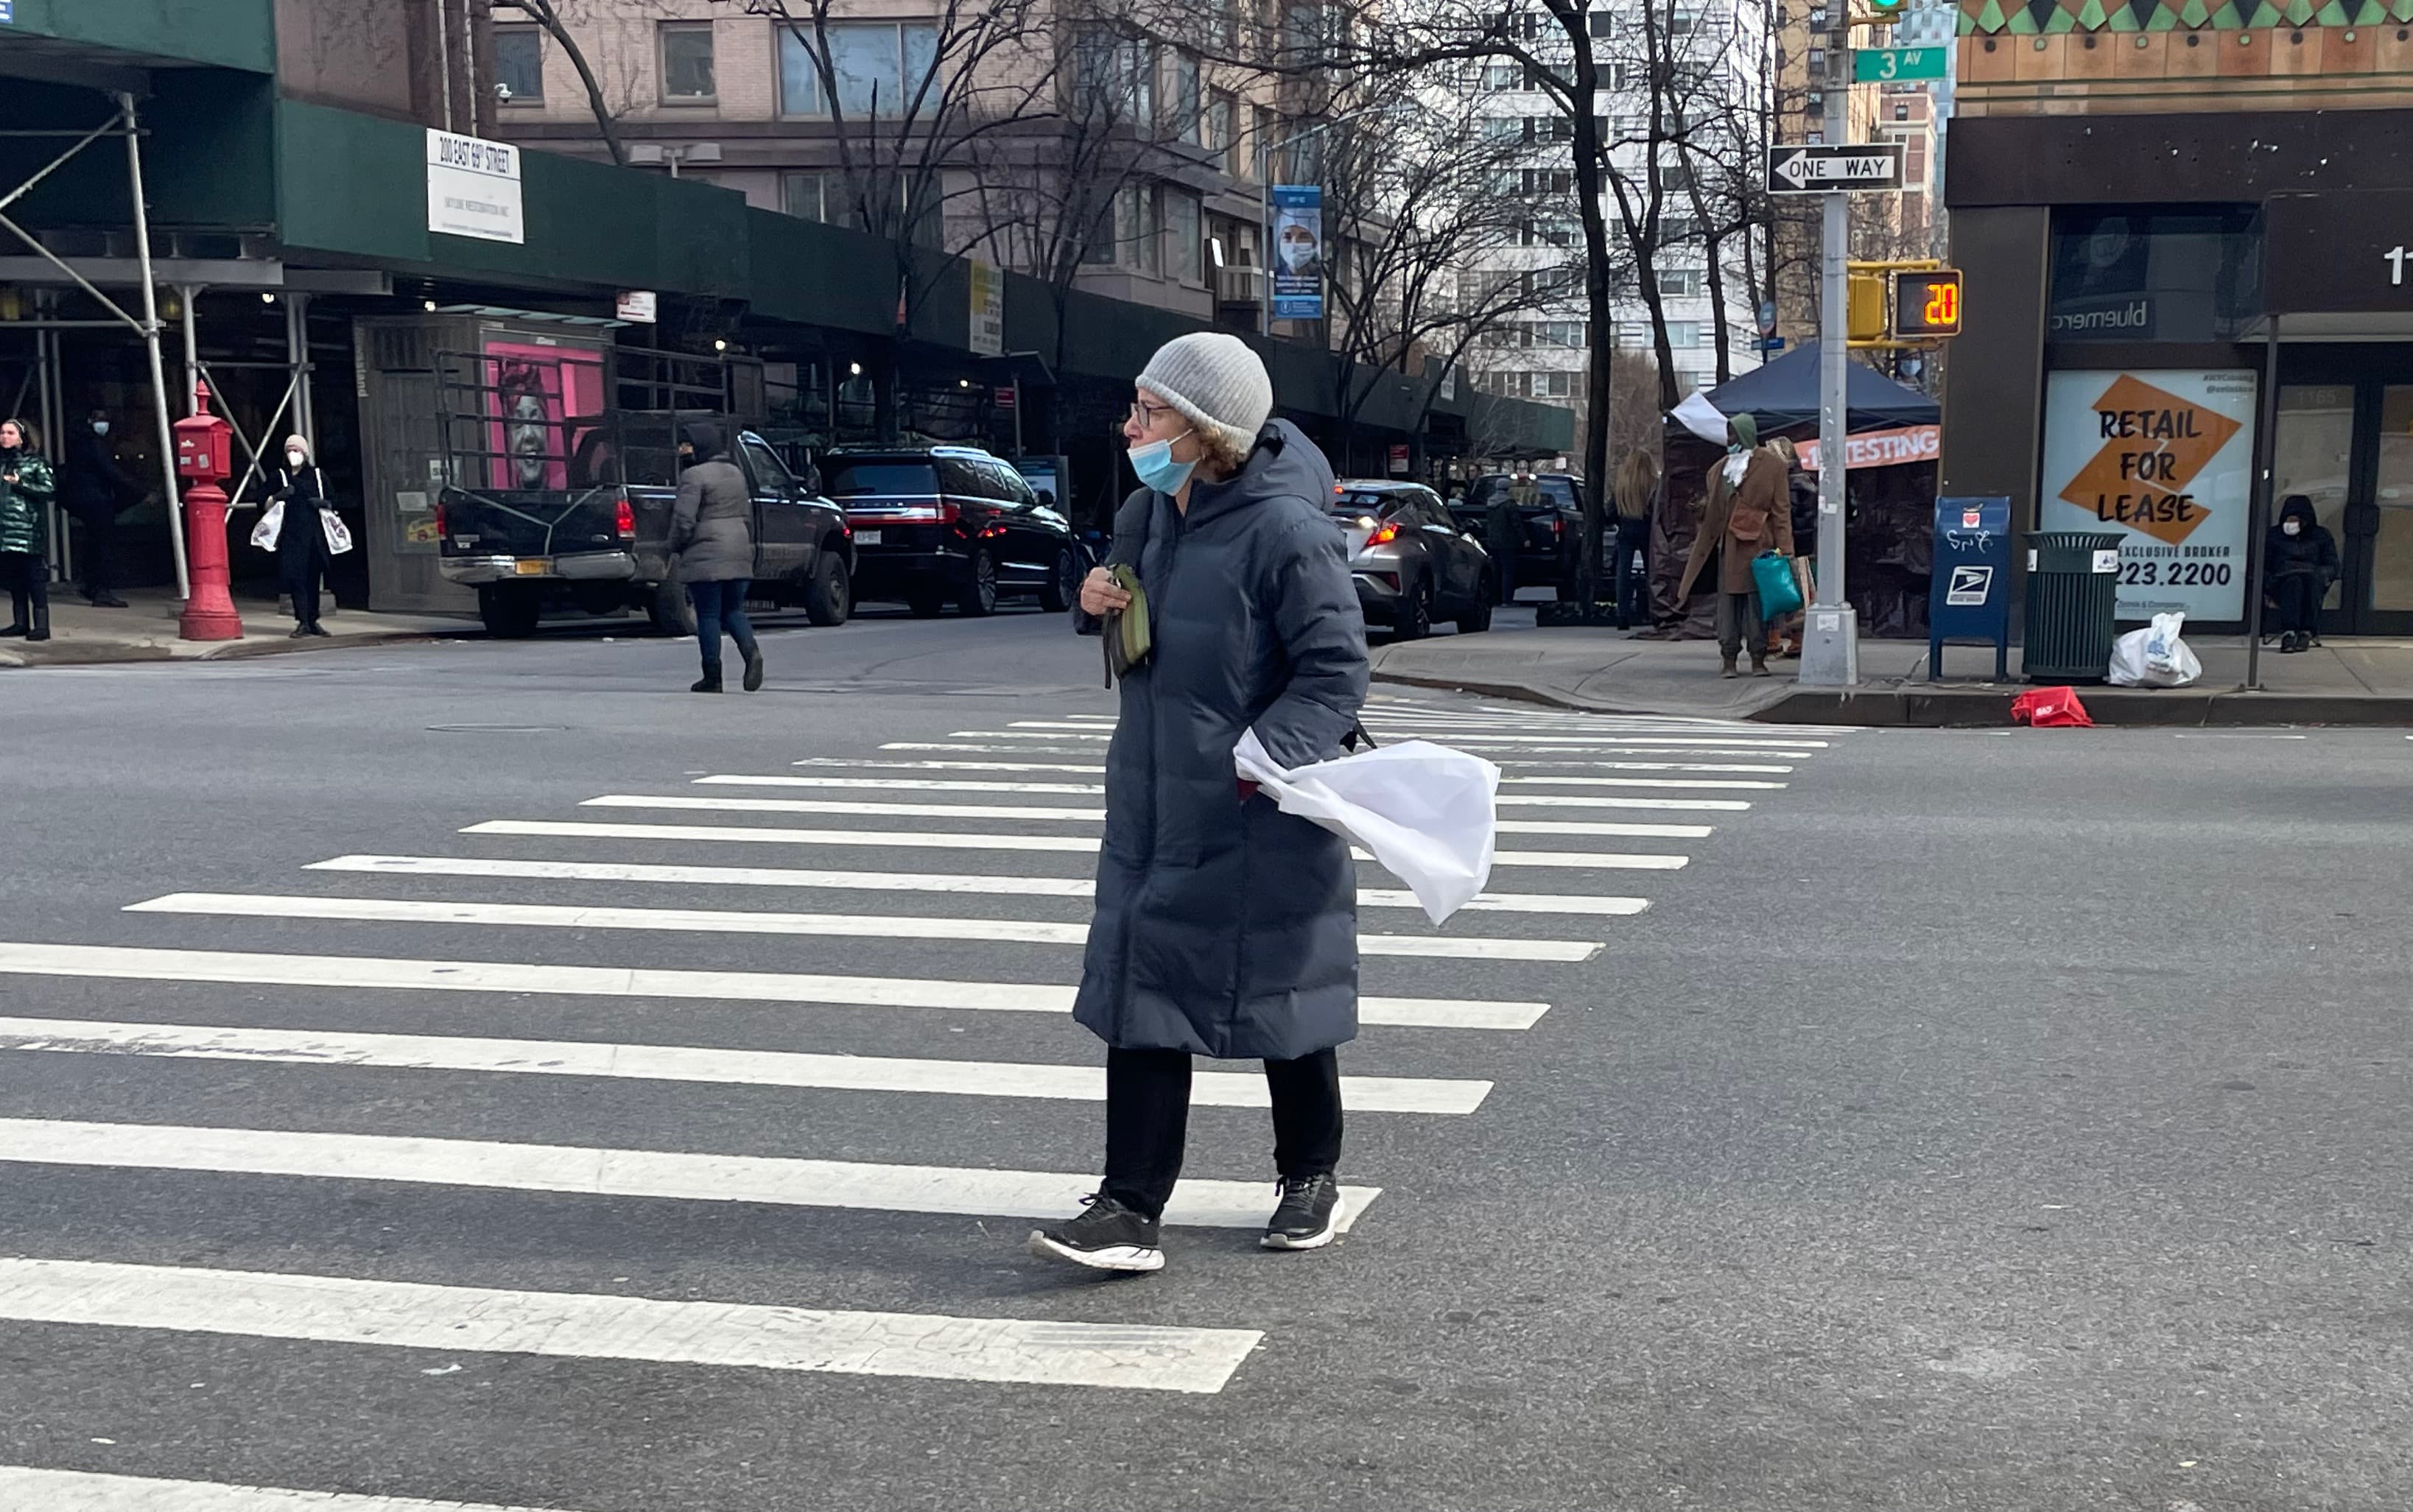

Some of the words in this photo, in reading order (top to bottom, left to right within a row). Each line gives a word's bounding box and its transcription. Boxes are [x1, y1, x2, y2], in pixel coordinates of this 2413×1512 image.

[1880, 52, 1897, 79] 3
[1904, 50, 1922, 66] AV
[440, 136, 453, 162] 200
[454, 139, 470, 166] EAST
[486, 146, 510, 174] STREET
[1789, 160, 1827, 177] ONE
[1846, 159, 1886, 176] WAY
[1925, 283, 1959, 325] 20
[2099, 409, 2202, 439] RETAIL
[2120, 451, 2177, 481] FOR
[2097, 493, 2194, 522] LEASE
[2118, 546, 2180, 558] EXCLUSIVE
[2185, 546, 2230, 558] BROKER
